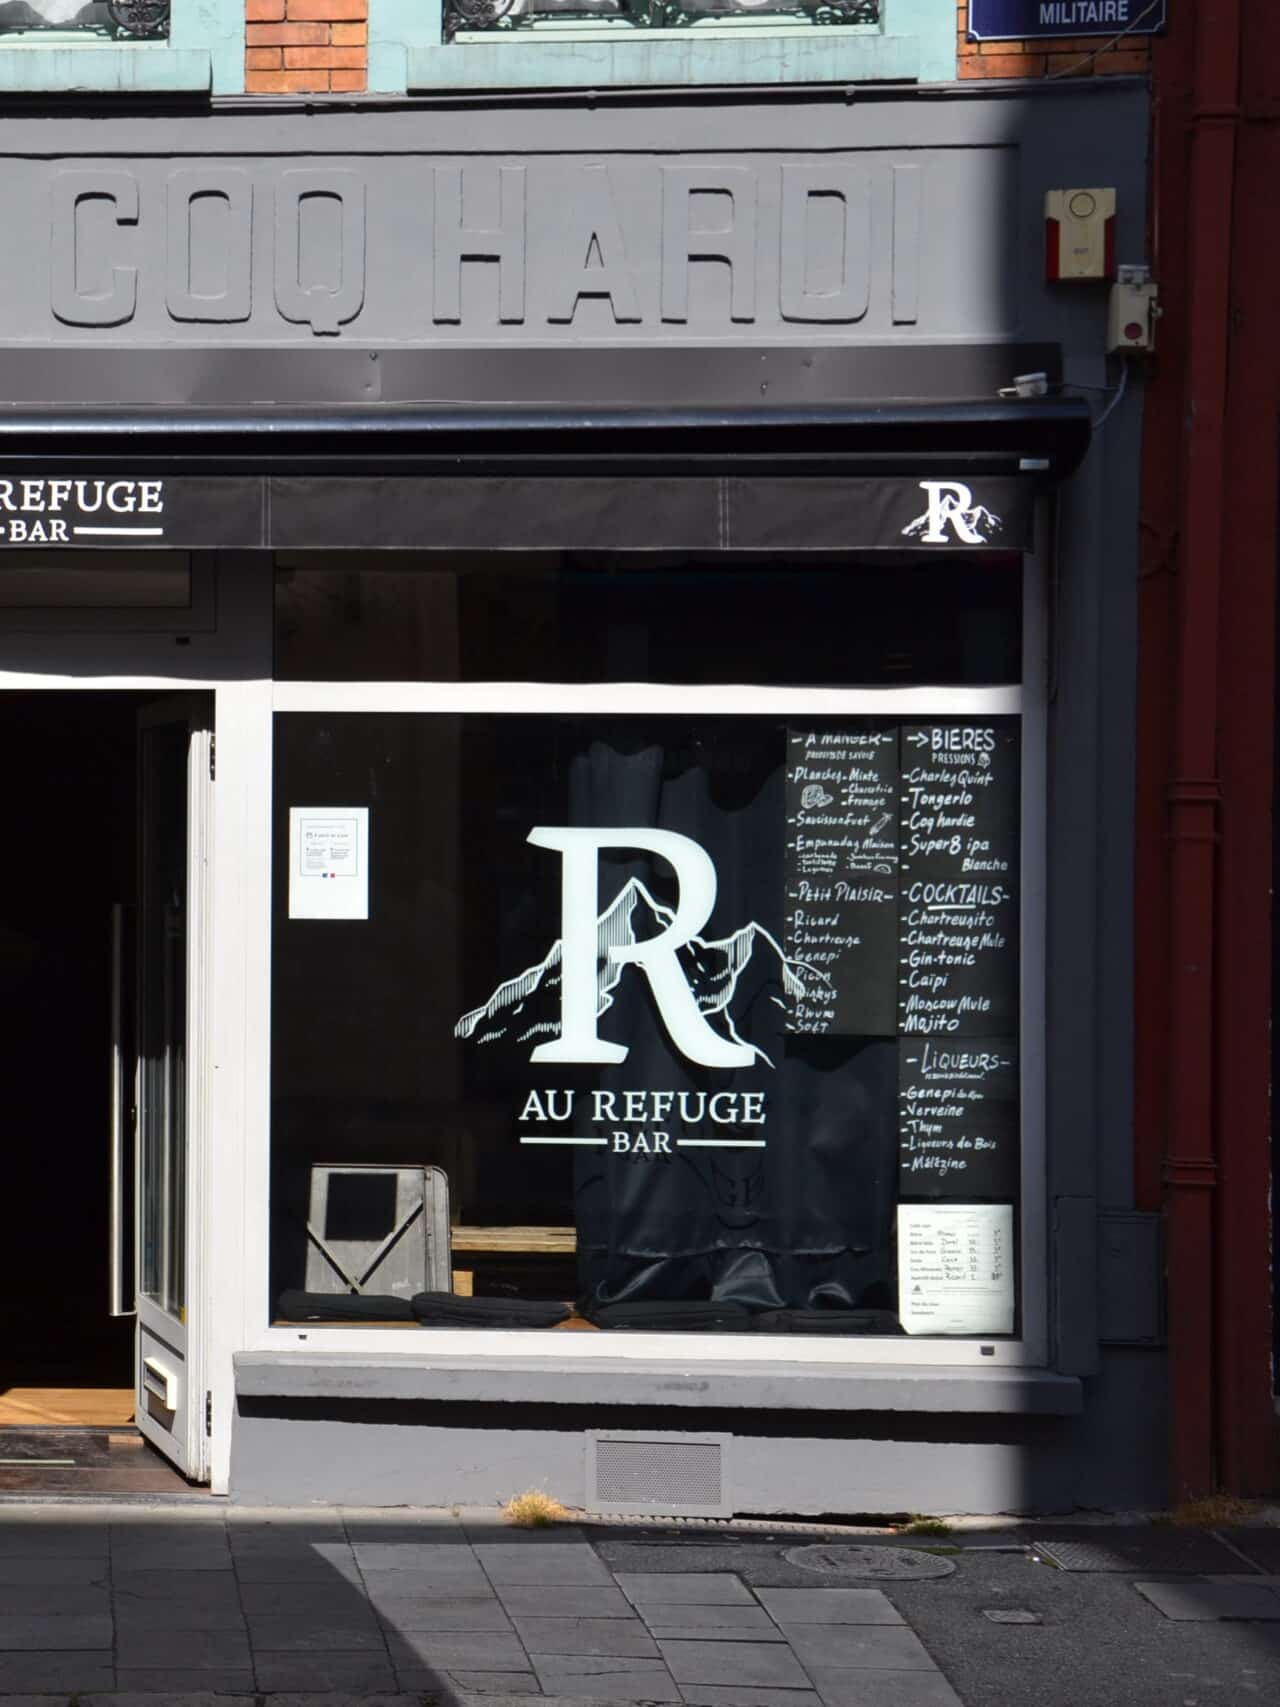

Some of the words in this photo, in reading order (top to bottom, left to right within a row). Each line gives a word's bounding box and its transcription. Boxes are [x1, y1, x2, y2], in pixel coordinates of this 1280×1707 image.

[1039, 1, 1129, 25] MILITAIRE
[50, 168, 366, 336] COQ
[432, 163, 918, 328] HARDI
[10, 520, 69, 541] BAR
[931, 728, 995, 751] BIERES
[932, 752, 976, 765] PRESSIONS
[908, 787, 973, 811] Tongerlo
[961, 858, 1009, 872] Blanche
[908, 882, 1002, 906] COCKTAILS
[794, 909, 840, 928] Ricard
[527, 827, 756, 1069] R
[978, 933, 1006, 950] Mule
[957, 996, 991, 1015] Mule
[904, 1014, 960, 1034] Mojito
[519, 1091, 573, 1121] AU
[592, 1091, 765, 1123] REFUGE
[906, 1102, 964, 1117] Verveine
[906, 1120, 942, 1136] Thym
[613, 1132, 671, 1153] BAR
